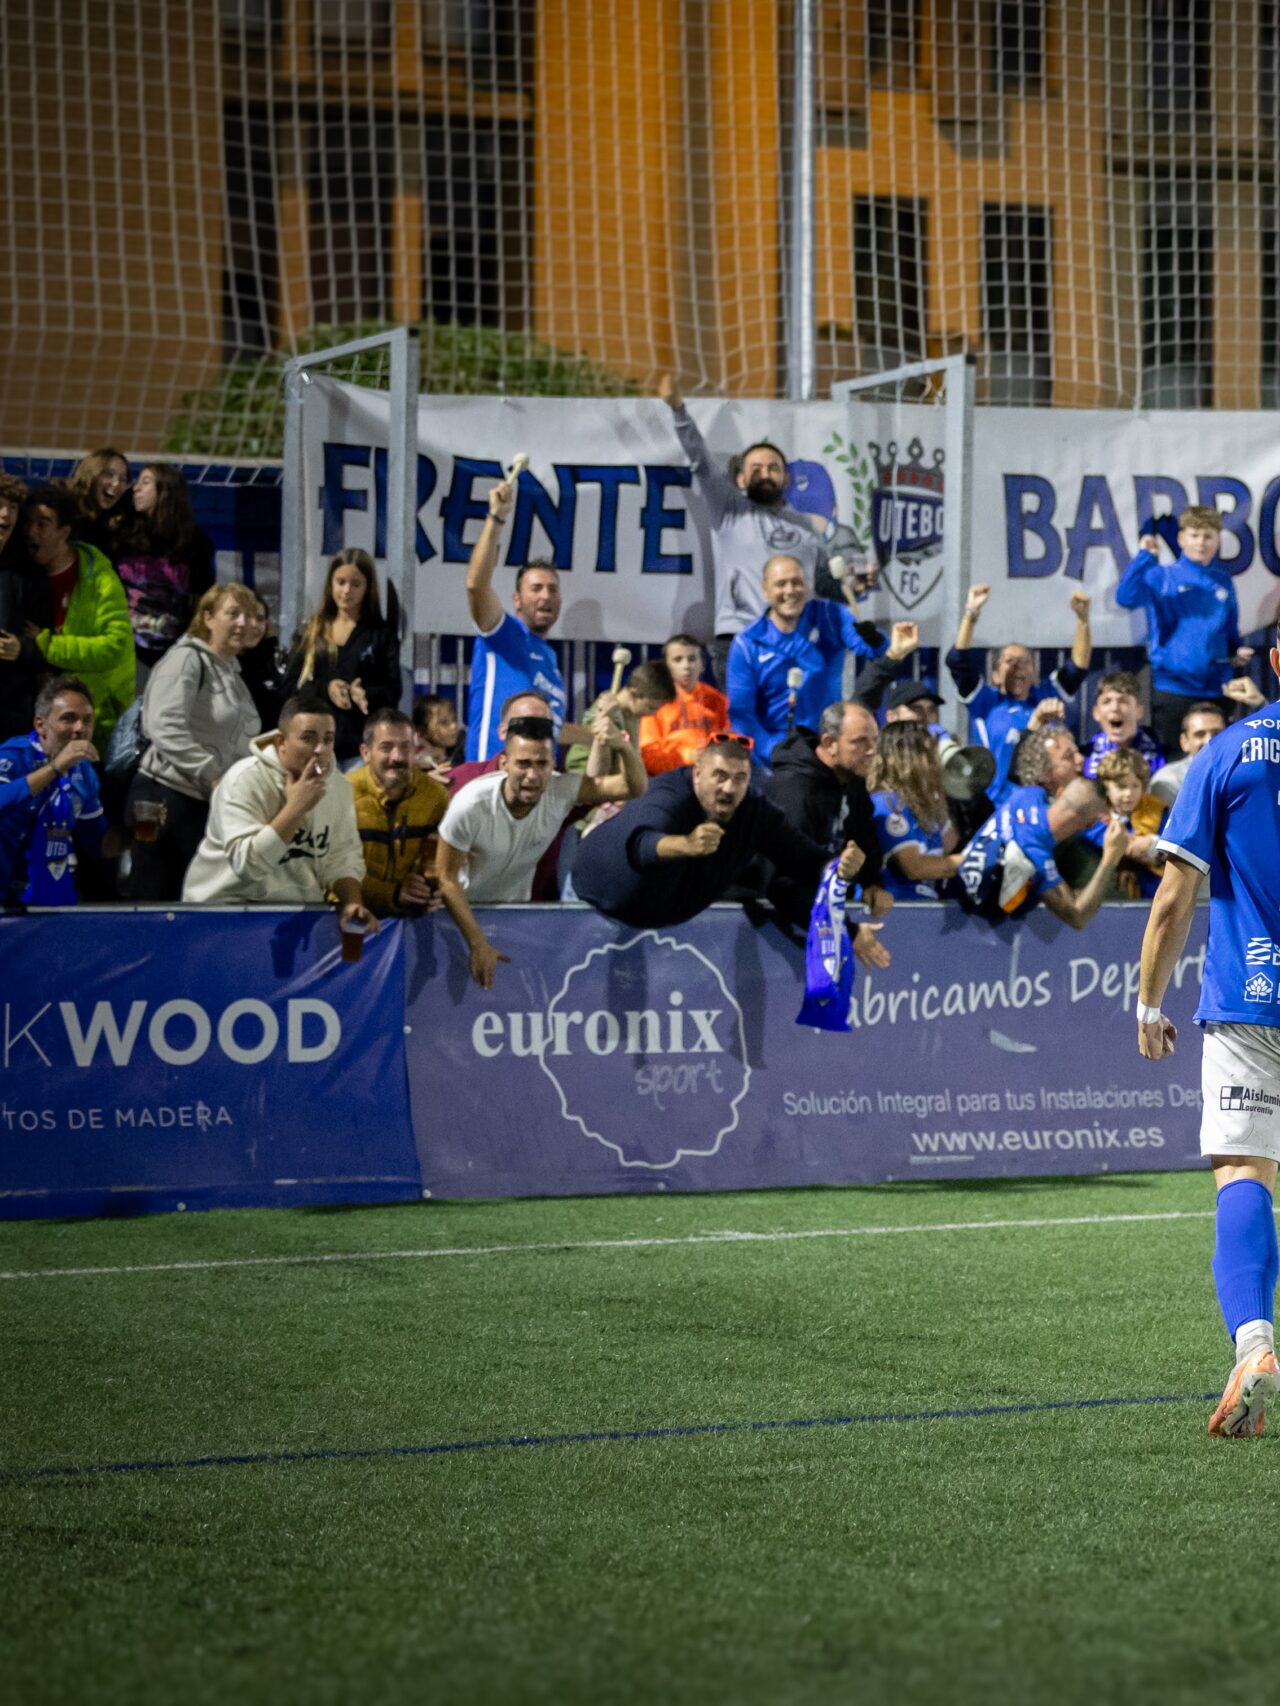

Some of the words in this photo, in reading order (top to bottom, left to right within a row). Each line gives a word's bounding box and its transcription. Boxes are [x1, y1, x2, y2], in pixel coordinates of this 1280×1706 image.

[318, 442, 693, 575] FRENTE
[900, 570, 920, 595] FC
[1241, 737, 1280, 763] ERIC
[846, 970, 1052, 1029] abricamos
[472, 991, 724, 1057] euronix
[635, 1059, 724, 1111] sport
[783, 1090, 875, 1117] Solución
[878, 1088, 952, 1119] Integral
[957, 1092, 1000, 1117] para
[1005, 1091, 1036, 1111] tus
[1041, 1084, 1164, 1112] Instalaciones
[68, 1108, 104, 1130] DE
[115, 1105, 234, 1128] MADERA
[911, 1122, 1165, 1152] www.euronix.es
